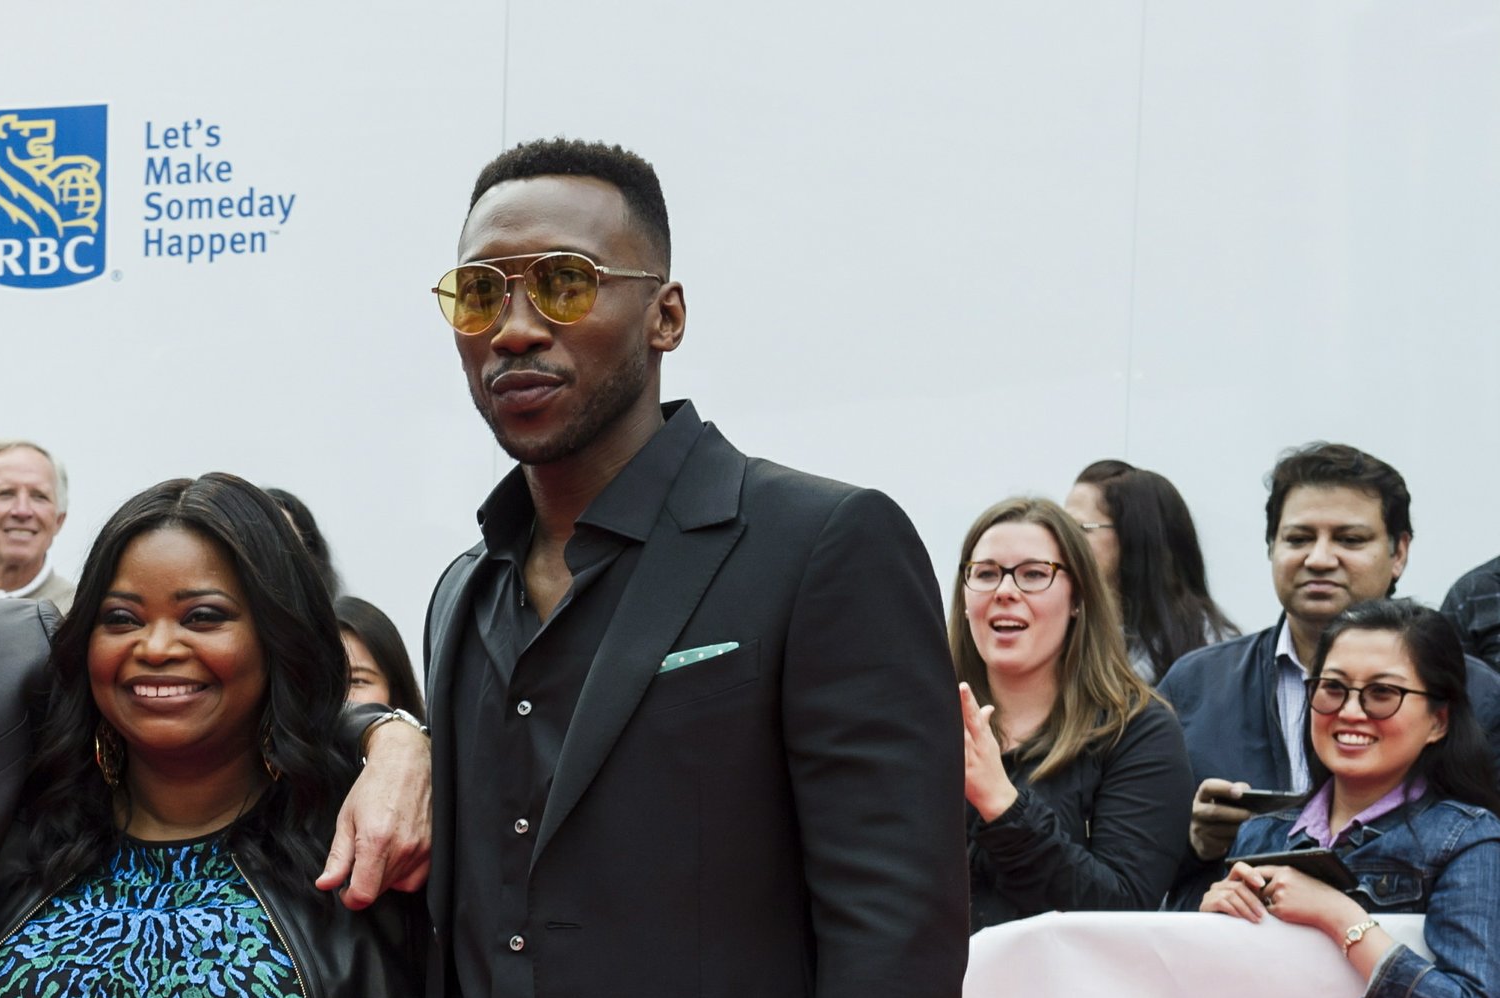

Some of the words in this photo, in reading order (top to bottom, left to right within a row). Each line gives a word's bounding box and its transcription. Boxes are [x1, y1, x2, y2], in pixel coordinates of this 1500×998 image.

[145, 118, 221, 150] Let's
[145, 153, 233, 186] Make
[144, 186, 296, 225] Someday
